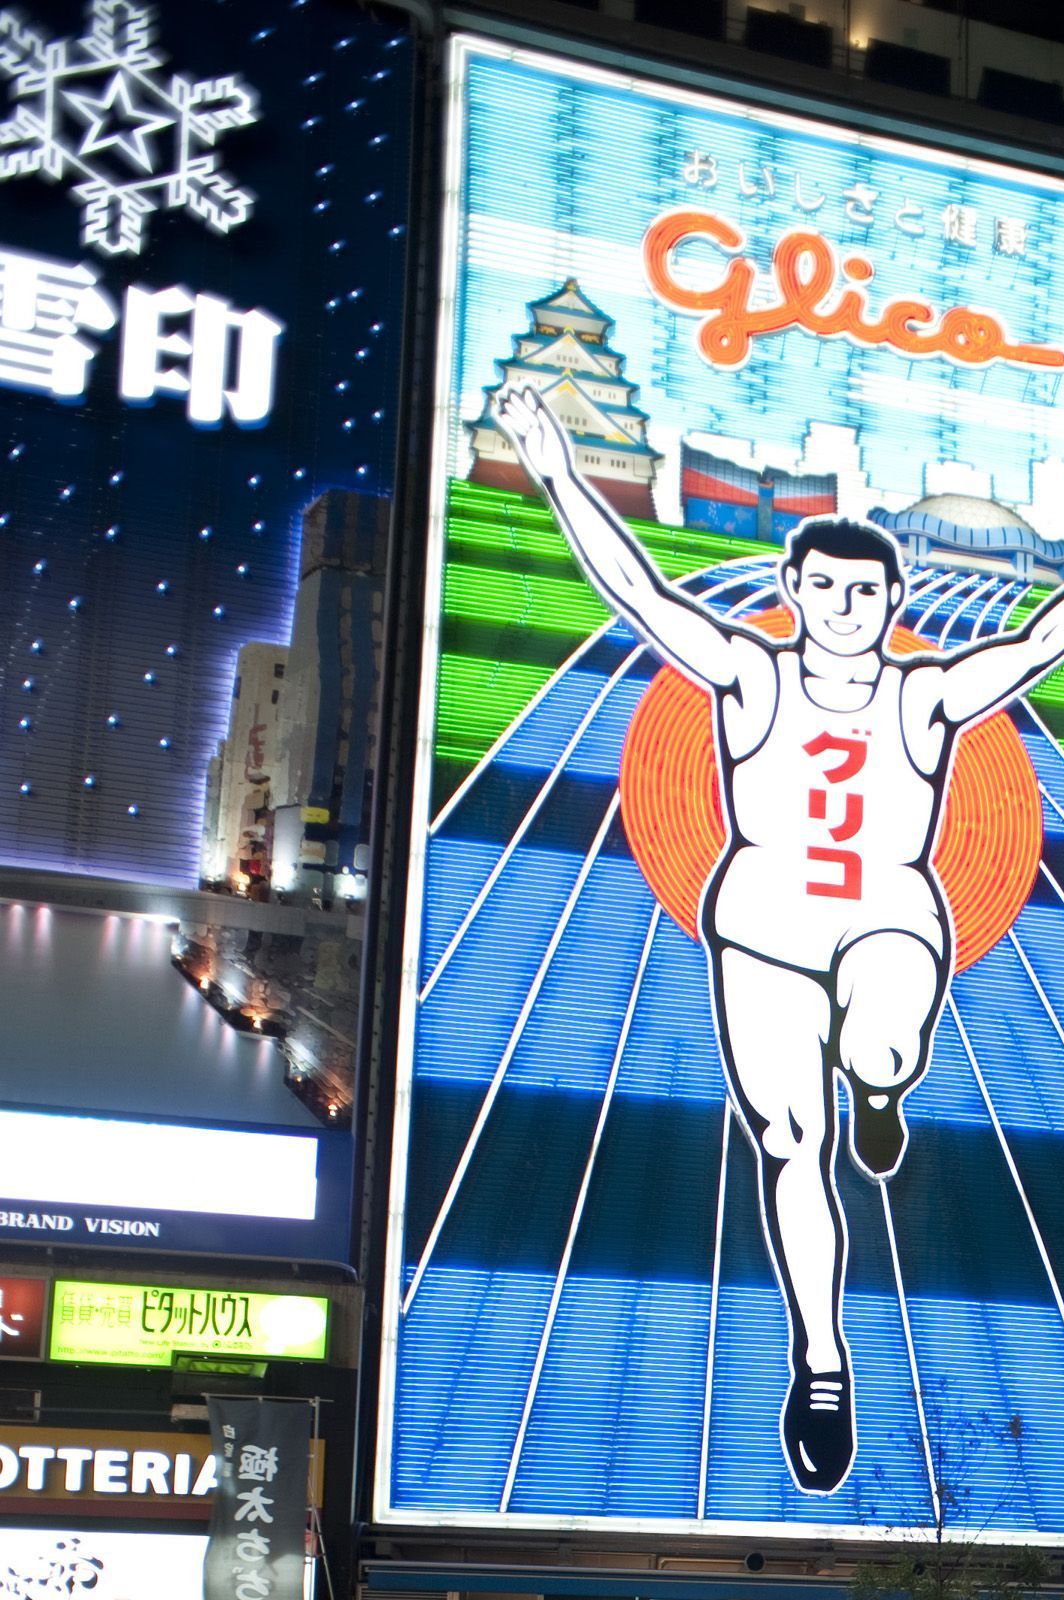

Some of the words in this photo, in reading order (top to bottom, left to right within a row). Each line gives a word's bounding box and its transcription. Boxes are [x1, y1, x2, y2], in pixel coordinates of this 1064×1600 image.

[683, 149, 1028, 257] おいしさと健康
[0, 246, 285, 423] 雪印
[802, 728, 872, 901] グリコ
[84, 1217, 161, 1238] VISION
[141, 1289, 252, 1338] ピタットハウス
